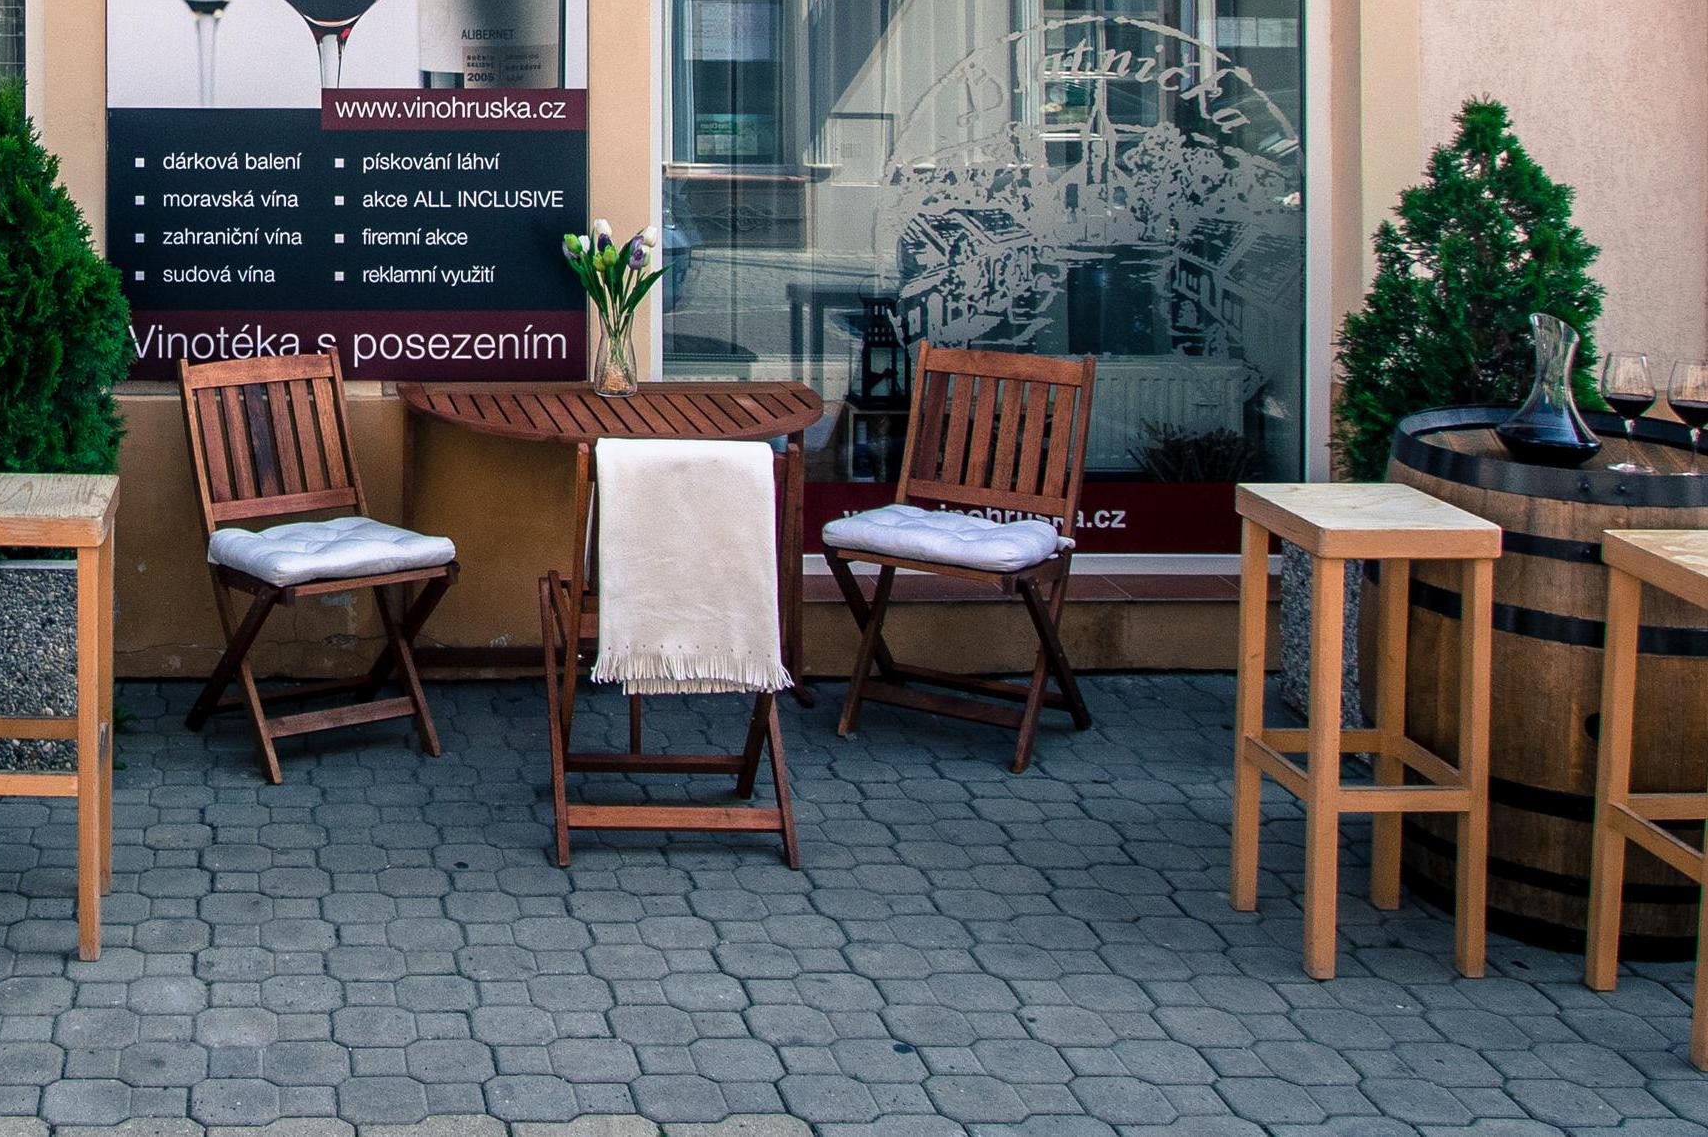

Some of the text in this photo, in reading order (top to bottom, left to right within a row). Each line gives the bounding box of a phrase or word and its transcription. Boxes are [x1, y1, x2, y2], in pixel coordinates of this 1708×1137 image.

[335, 96, 567, 119] www.vinohruska.cz
[163, 152, 302, 170] dárková balení
[363, 152, 500, 173] pískování láhví
[163, 190, 299, 207] moravská vína
[362, 190, 564, 208] akce ALL INCLUSIVE
[163, 228, 303, 245] zahraniční vína
[362, 228, 468, 245] firemní akce
[163, 265, 276, 283] sudová vína
[363, 265, 496, 287] reklamní využití
[128, 324, 567, 367] Vinotéka s posezením
